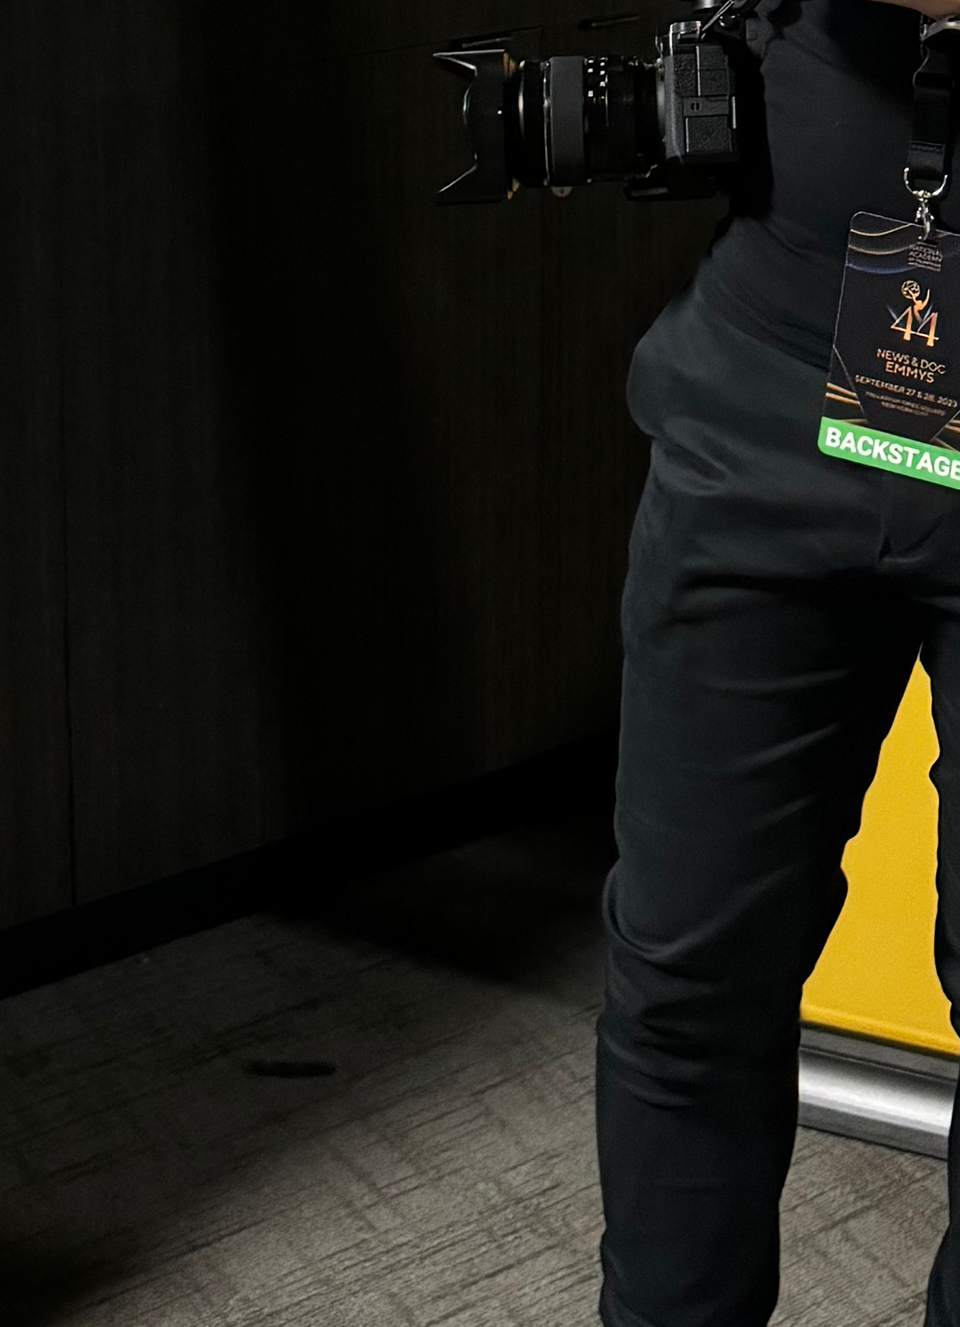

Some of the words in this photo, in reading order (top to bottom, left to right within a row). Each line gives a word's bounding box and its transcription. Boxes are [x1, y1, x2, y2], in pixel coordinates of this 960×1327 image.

[890, 305, 939, 347] 44
[876, 348, 910, 365] NEWS
[911, 357, 919, 367] &
[920, 359, 946, 374] DOC
[885, 361, 934, 383] EMMYS
[855, 374, 905, 393] SEPTEMBER
[905, 388, 916, 396] 27
[937, 396, 957, 408] 2023
